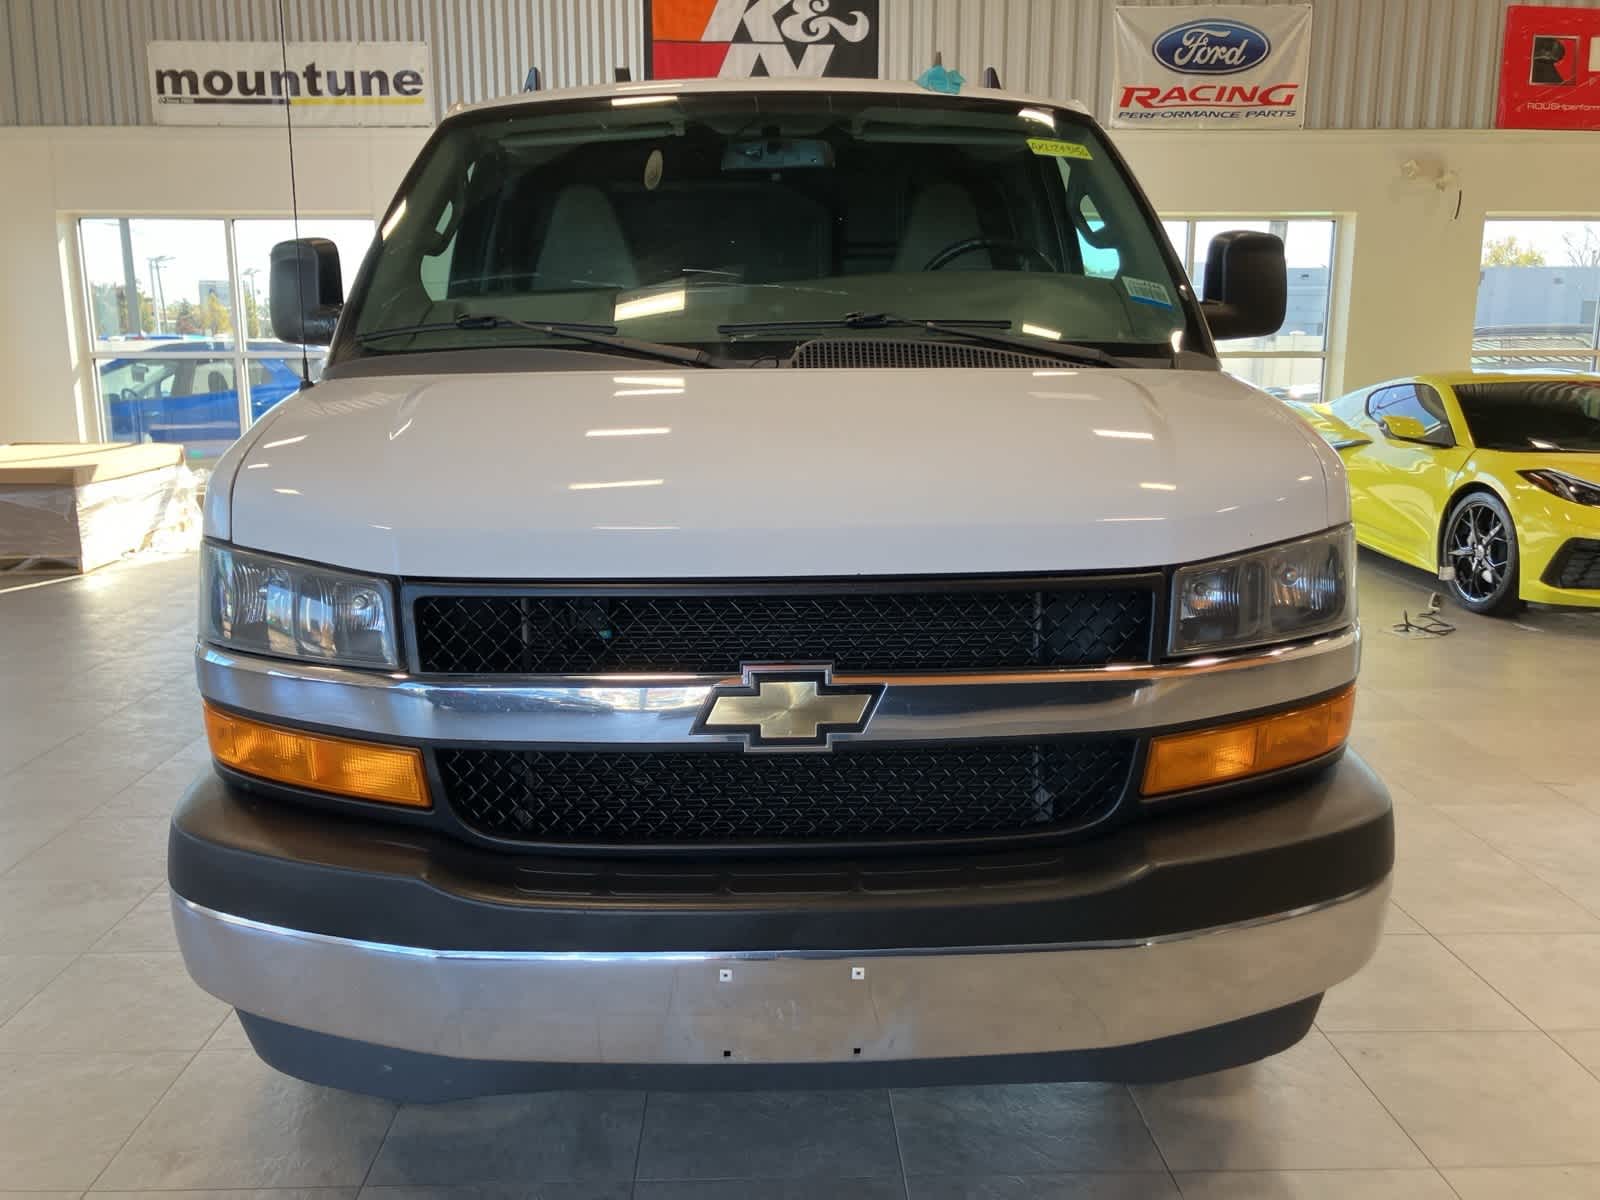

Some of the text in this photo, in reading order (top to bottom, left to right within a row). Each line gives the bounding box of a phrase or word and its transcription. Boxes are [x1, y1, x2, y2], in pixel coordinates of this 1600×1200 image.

[1174, 28, 1248, 66] Ford
[155, 62, 424, 96] mountune
[1119, 84, 1299, 109] RACING
[1118, 109, 1297, 119] PERFORMANCE PARTS
